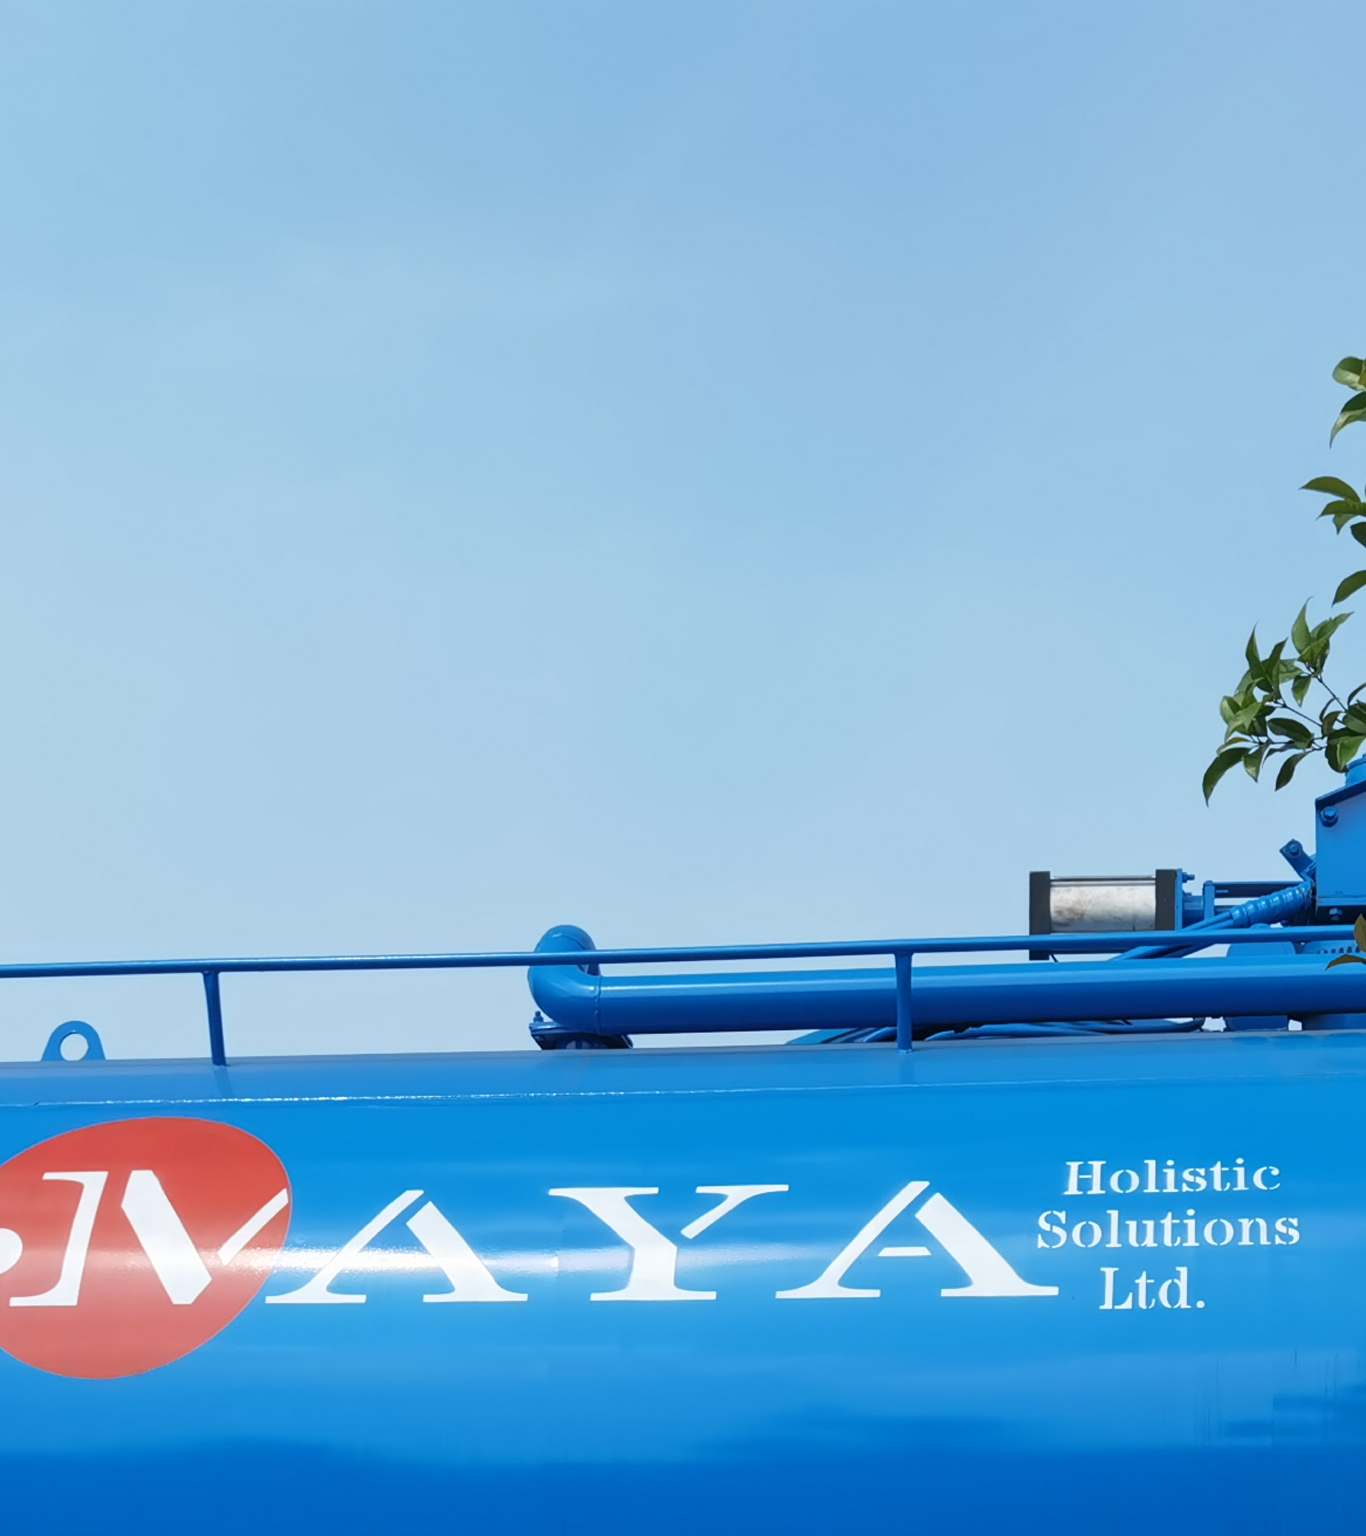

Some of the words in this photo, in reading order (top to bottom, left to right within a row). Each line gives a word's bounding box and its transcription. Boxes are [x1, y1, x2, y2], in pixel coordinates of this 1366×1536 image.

[1063, 1157, 1281, 1196] Holistic
[1037, 1208, 1300, 1249] Solutions
[1099, 1266, 1206, 1310] Ltd.
